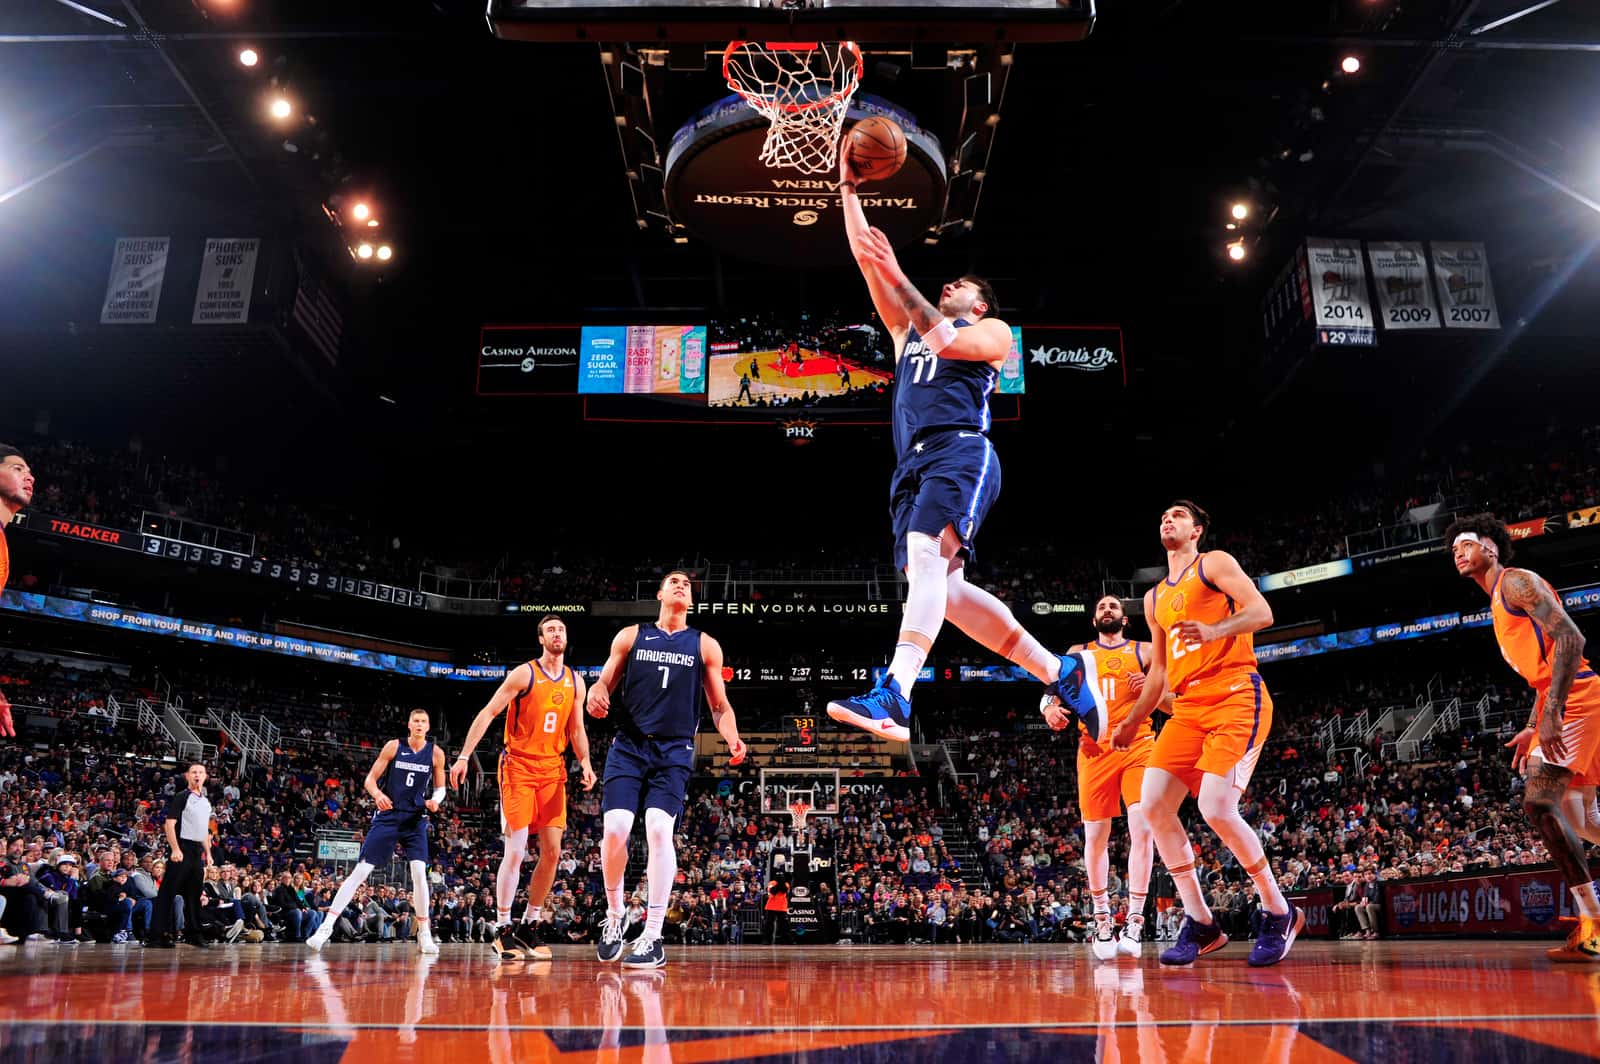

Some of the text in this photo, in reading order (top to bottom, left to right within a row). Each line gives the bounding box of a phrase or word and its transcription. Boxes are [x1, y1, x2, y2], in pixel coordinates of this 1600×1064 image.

[771, 180, 843, 192] ARENA
[694, 194, 918, 210] TALKIG STICK RESORT
[118, 240, 166, 252] PHOENIX
[209, 241, 257, 253] PHOENIX
[124, 254, 153, 265] SUNS
[215, 254, 243, 266] SUNS
[207, 291, 241, 299] WESTERN
[199, 301, 245, 309] CONFERENCE
[199, 311, 242, 320] CHAMPIONS
[1323, 305, 1364, 320] 2014
[1389, 309, 1432, 322] 2009
[1450, 309, 1492, 322] 2007
[1329, 332, 1347, 344] 29
[481, 345, 577, 356] CASINO ARIZONA
[1046, 347, 1118, 365] Carl's Jr.
[626, 357, 654, 366] BERRY
[910, 354, 938, 384] 77
[786, 426, 814, 438] PHX
[51, 519, 121, 545] TRACKER
[147, 540, 160, 552] 3
[169, 544, 182, 557] 3
[190, 548, 203, 561] 3
[211, 552, 224, 566] 3
[231, 556, 243, 569] 3
[250, 560, 263, 574] 3
[270, 565, 282, 578] 3
[290, 569, 301, 582] 3
[308, 573, 319, 585] 3
[326, 576, 338, 589] 3
[345, 580, 355, 592] 3
[362, 584, 373, 596] 3
[379, 588, 390, 600] 3
[396, 591, 407, 603] 3
[1566, 597, 1583, 607] ON
[520, 604, 586, 613] KONICA MINOLTA
[761, 604, 817, 613] VODKA
[823, 604, 890, 613] LOUNGE
[1052, 604, 1086, 613] ARIZONA
[1376, 611, 1492, 638] SHOP FROM YOUR SEATS
[91, 608, 361, 661] SHOP FROM YOUR SEATS AND PICK UP ON YOUR WAY HOME.
[635, 648, 696, 667] MAVERICKS
[430, 665, 455, 675] SHOP
[455, 667, 481, 677] FROM
[481, 667, 507, 677] YOUR
[657, 665, 670, 689] 7
[736, 669, 752, 680] 12
[792, 667, 811, 676] 7:37
[852, 669, 868, 680] 12
[945, 668, 952, 680] 5
[1102, 678, 1115, 701] 11
[543, 711, 558, 733] 8
[794, 718, 814, 728] 7:37
[800, 728, 812, 745] 5
[406, 771, 416, 787] 6
[1418, 889, 1468, 923] LUCAS
[1474, 886, 1505, 921] OIL
